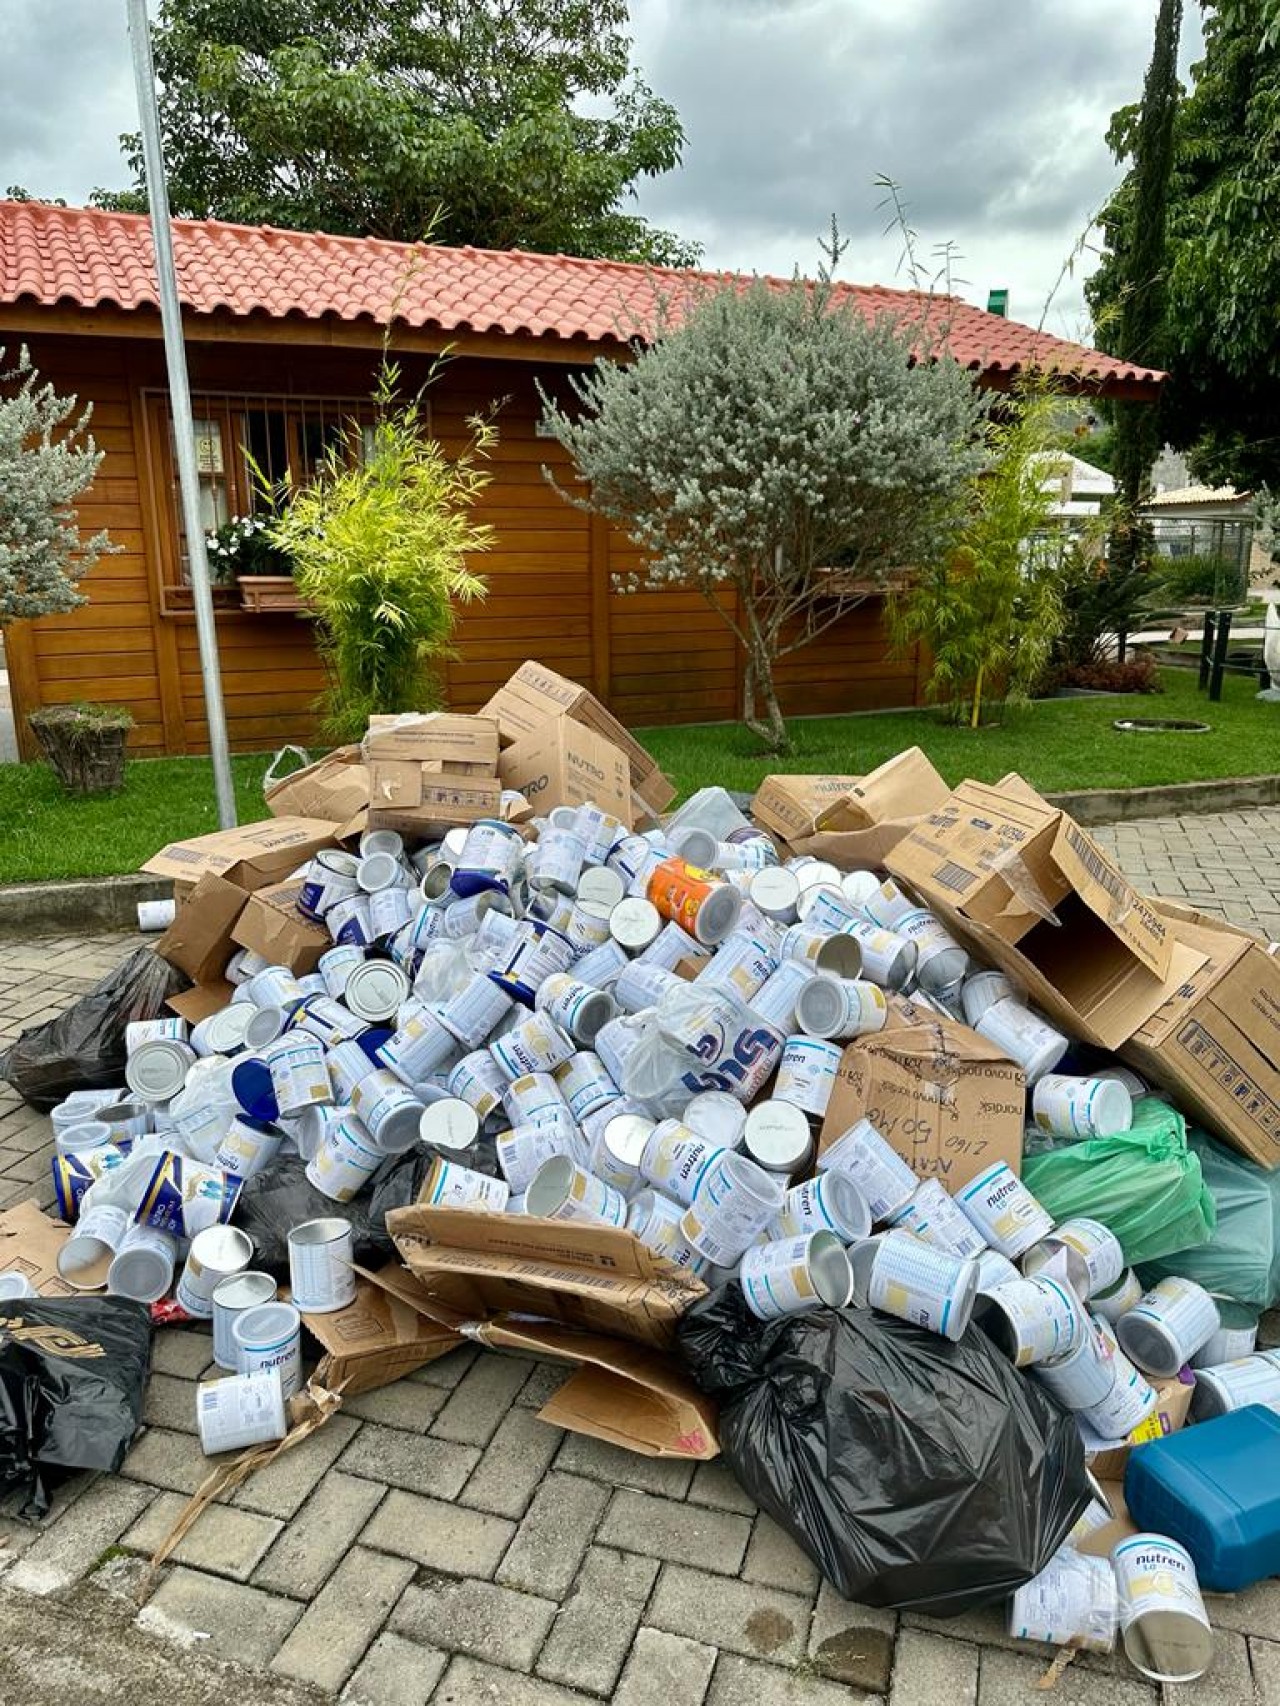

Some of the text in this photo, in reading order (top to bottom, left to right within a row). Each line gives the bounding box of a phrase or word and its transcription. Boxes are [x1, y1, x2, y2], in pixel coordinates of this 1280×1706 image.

[984, 1067, 1015, 1081] novo
[978, 1101, 1024, 1116] nordisk
[679, 1143, 706, 1181] nutren
[986, 1179, 1018, 1208] nutren
[1135, 1553, 1186, 1571] nutren
